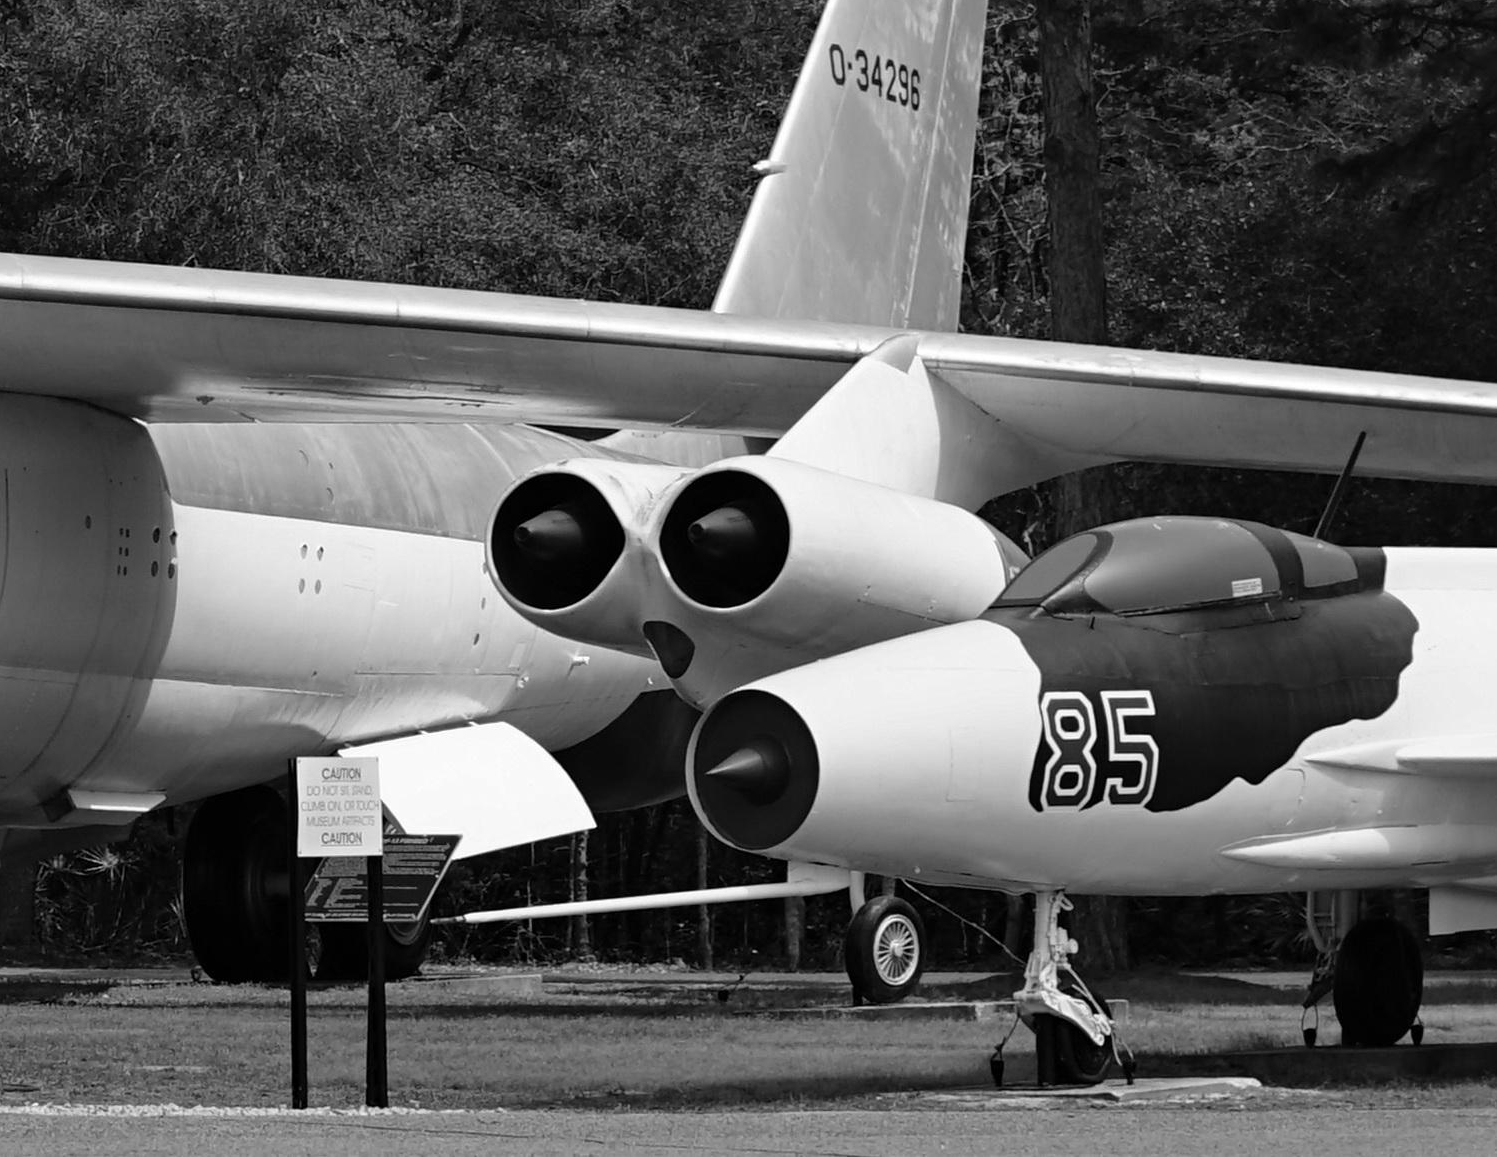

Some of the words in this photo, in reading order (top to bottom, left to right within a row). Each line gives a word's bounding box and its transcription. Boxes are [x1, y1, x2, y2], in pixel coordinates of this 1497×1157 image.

[1040, 690, 1160, 810] 85
[322, 768, 361, 780] CAUTION
[307, 785, 320, 796] DO
[322, 785, 338, 796] NOT
[301, 800, 325, 811] CLIMB
[306, 815, 340, 827] MUSEUM
[321, 832, 362, 844] CAUTION
